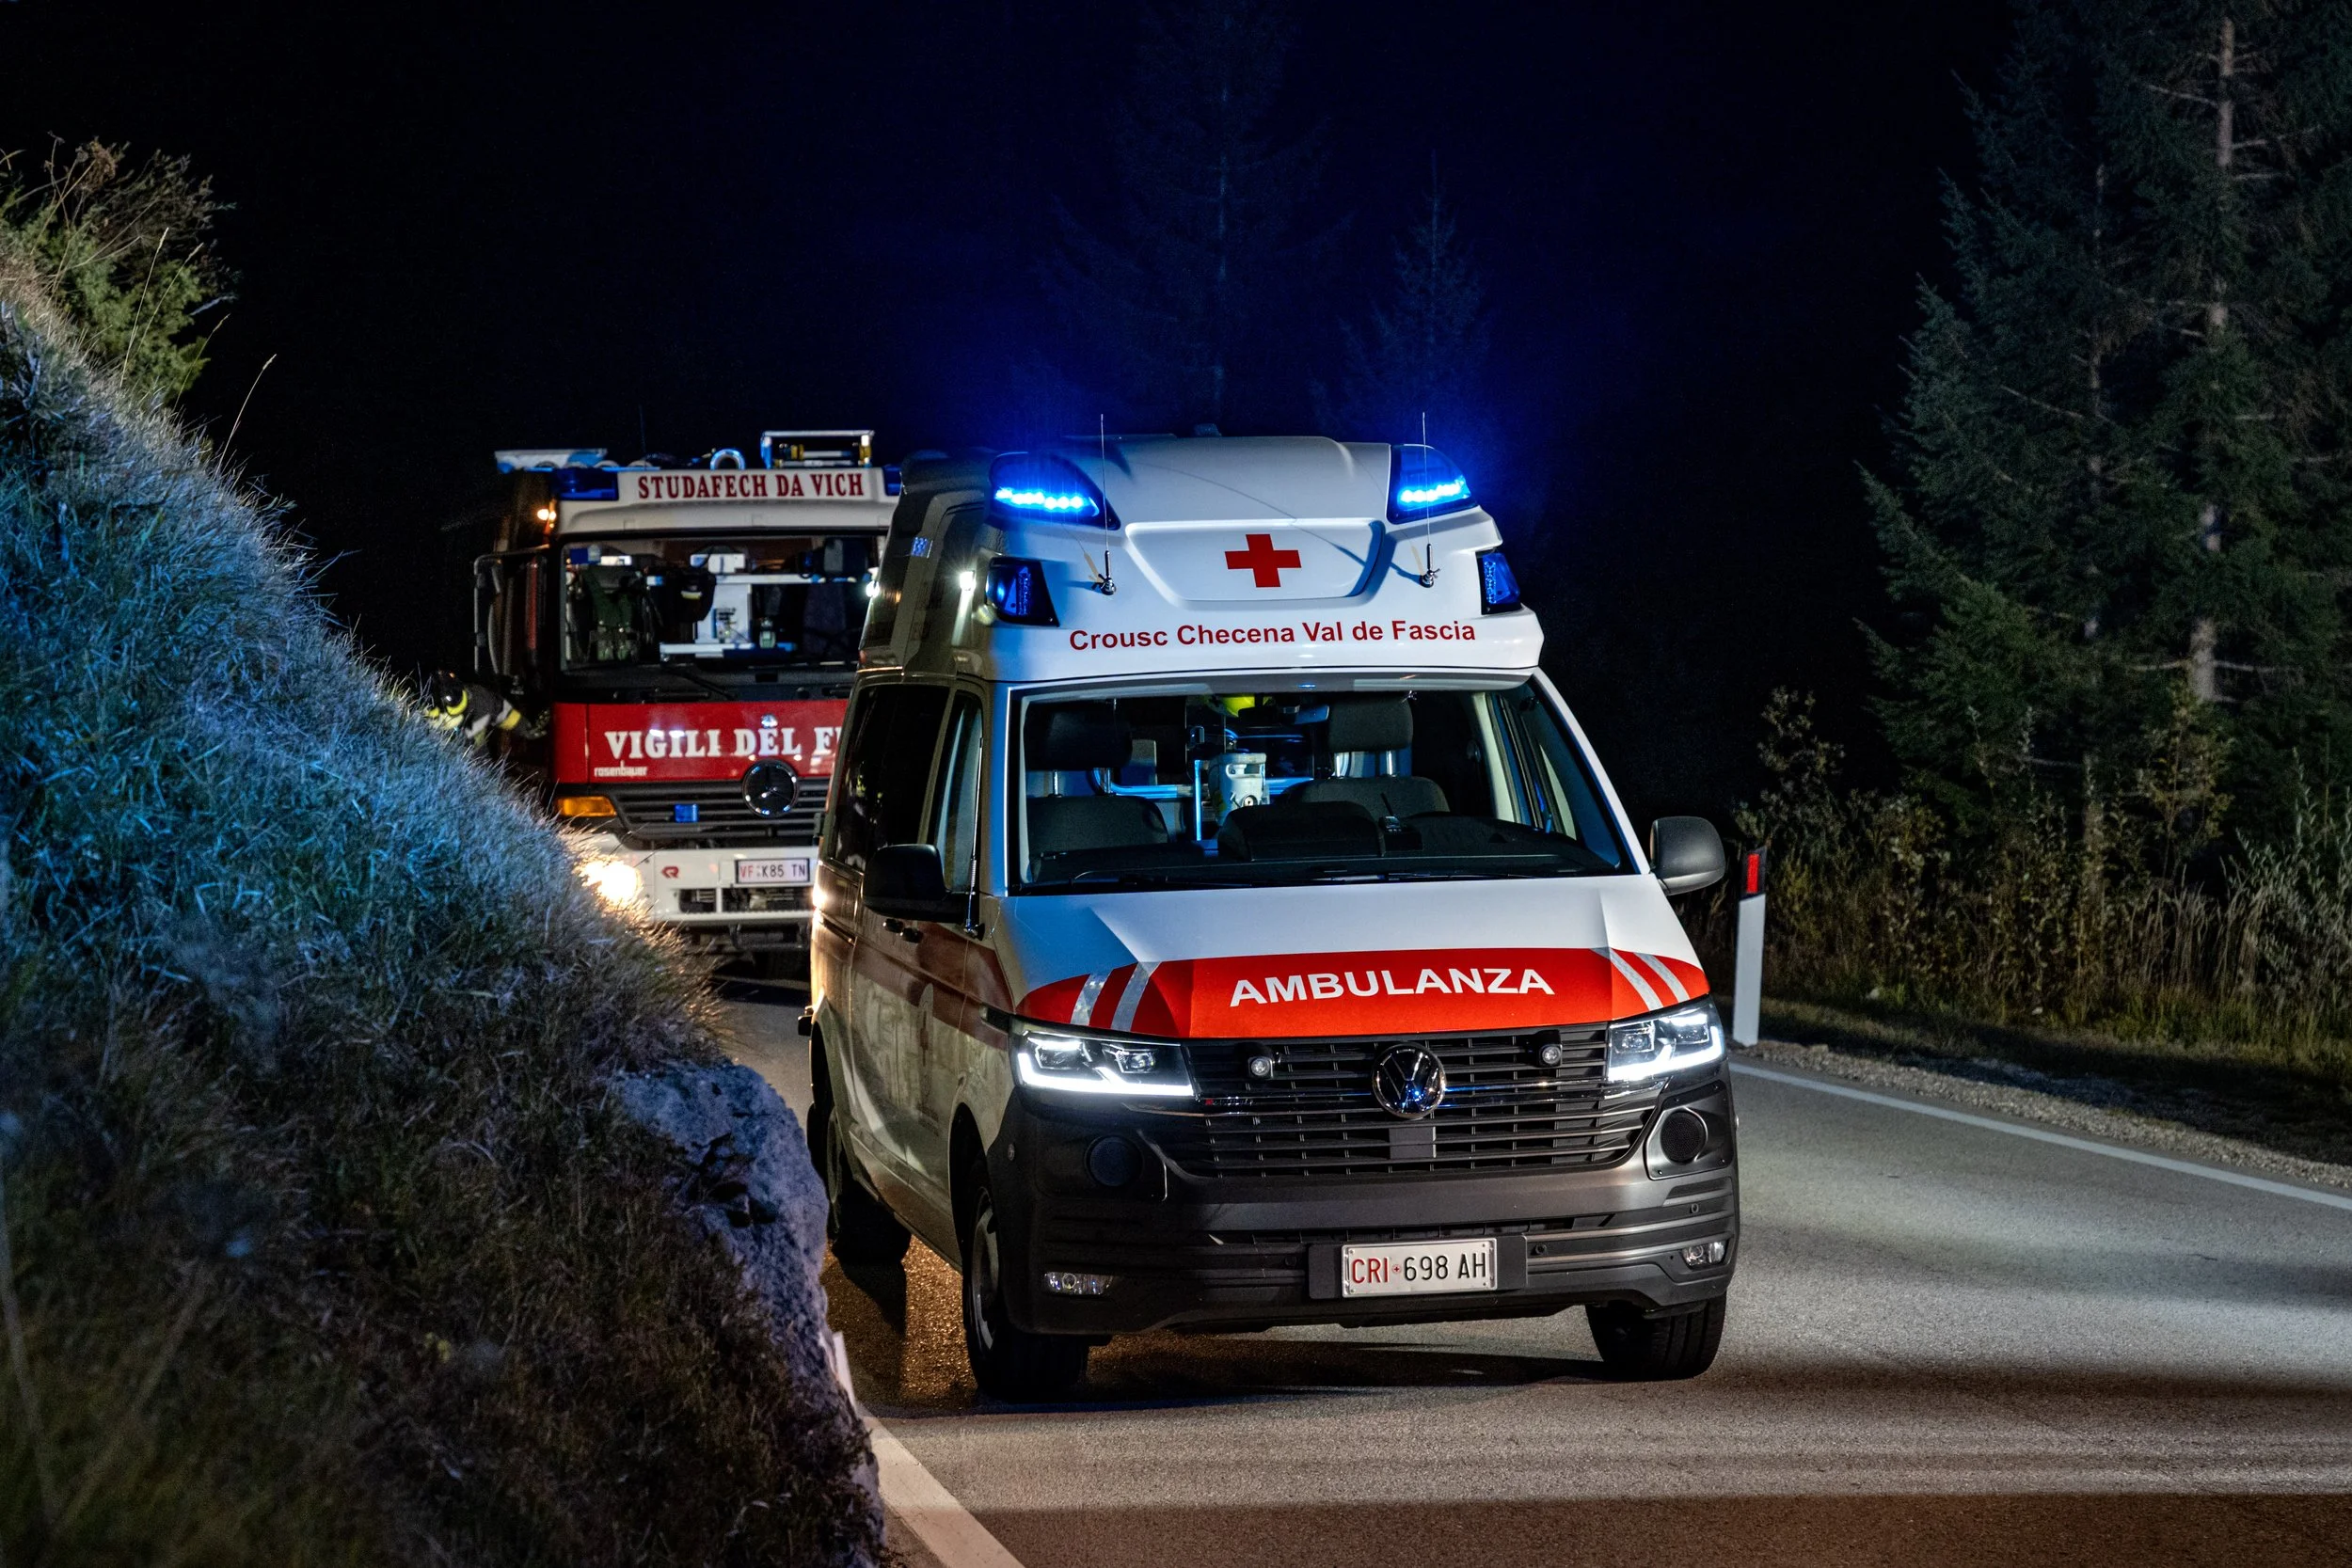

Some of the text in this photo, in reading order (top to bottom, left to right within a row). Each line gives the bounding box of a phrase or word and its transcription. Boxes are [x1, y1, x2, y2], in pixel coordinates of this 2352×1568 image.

[638, 472, 864, 499] STUDAFECH DA VICH
[1070, 620, 1476, 650] Crousc Checena Val de Fascia
[604, 729, 722, 759] VIGILI
[734, 727, 802, 756] DEL
[739, 863, 806, 878] VF K85 TN
[1230, 968, 1555, 1006] AMBULANZA
[1352, 1252, 1487, 1284] CRI 698 AH
